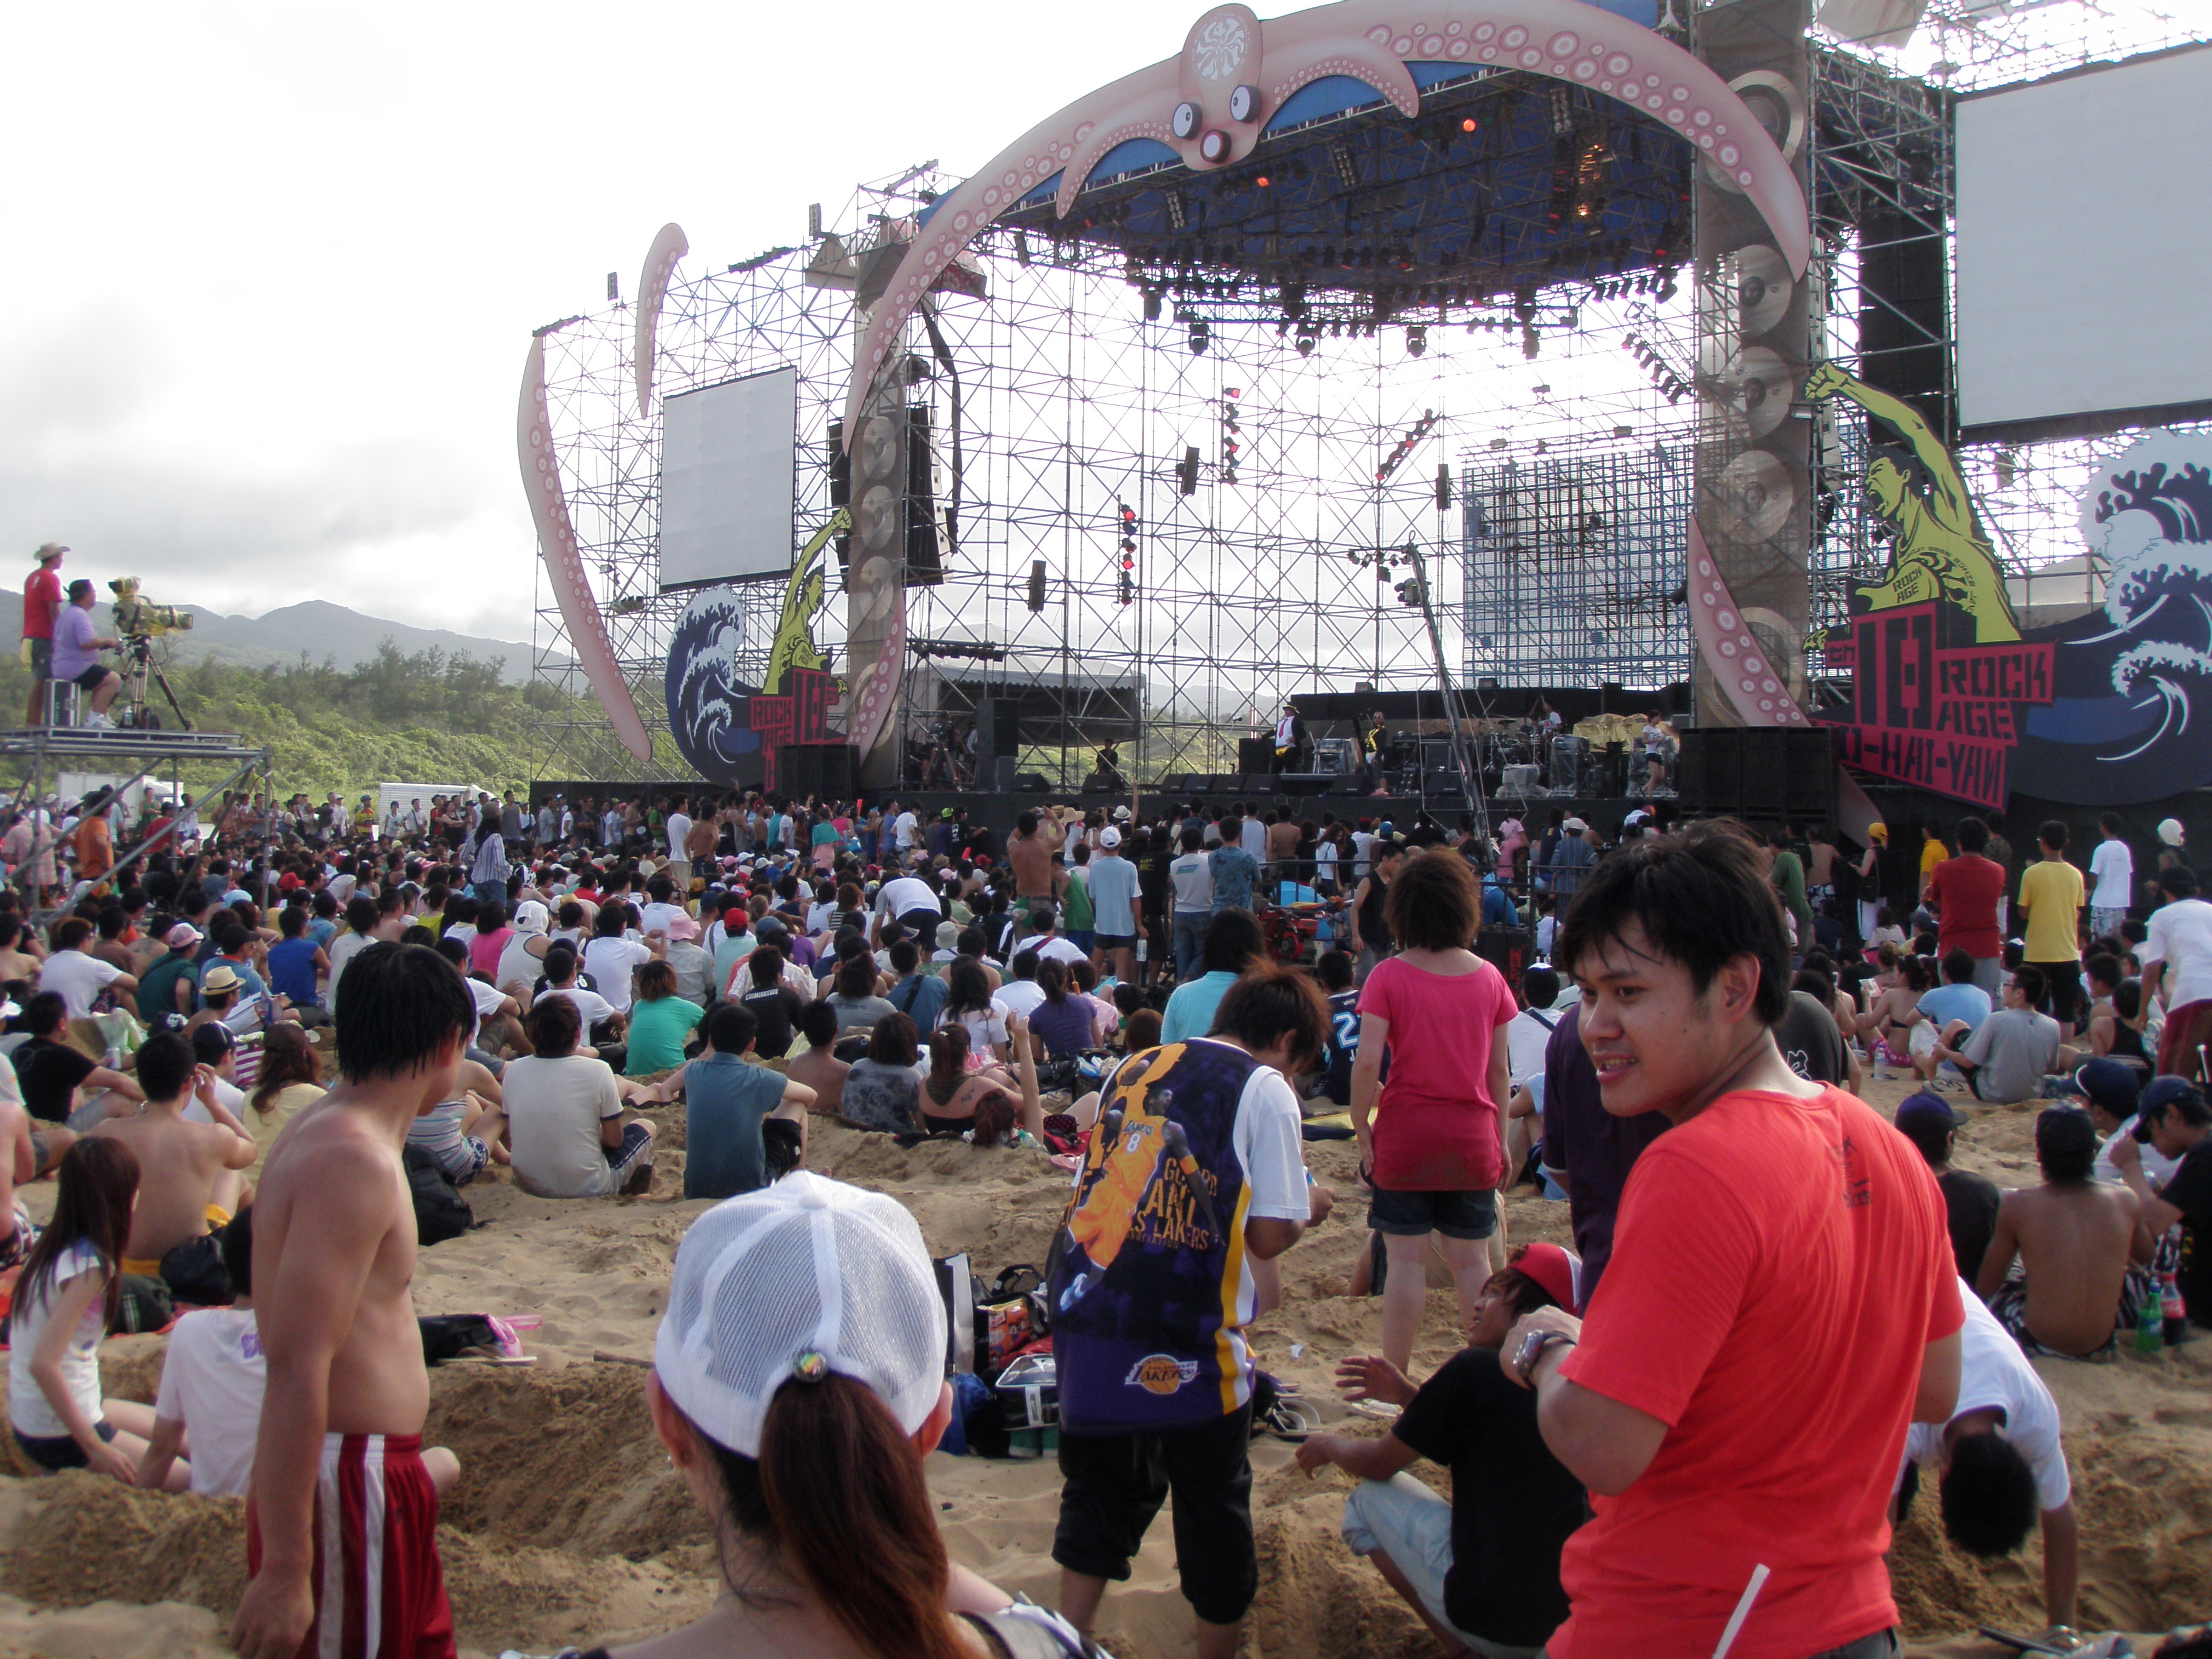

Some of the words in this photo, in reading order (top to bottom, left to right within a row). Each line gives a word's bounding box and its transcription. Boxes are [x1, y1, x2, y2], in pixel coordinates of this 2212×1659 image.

[1892, 566, 1922, 592] ROCK
[1897, 582, 1919, 603] AGE
[1828, 645, 1855, 663] th
[1939, 651, 2046, 698] ROCK
[753, 699, 791, 727] ROCK
[1936, 701, 2013, 740] AGE
[1834, 727, 2002, 803] O-HAI-YAN
[1127, 1133, 1141, 1152] 8
[1153, 1218, 1209, 1250] LAKERS
[1130, 1364, 1196, 1382] LAKERS
